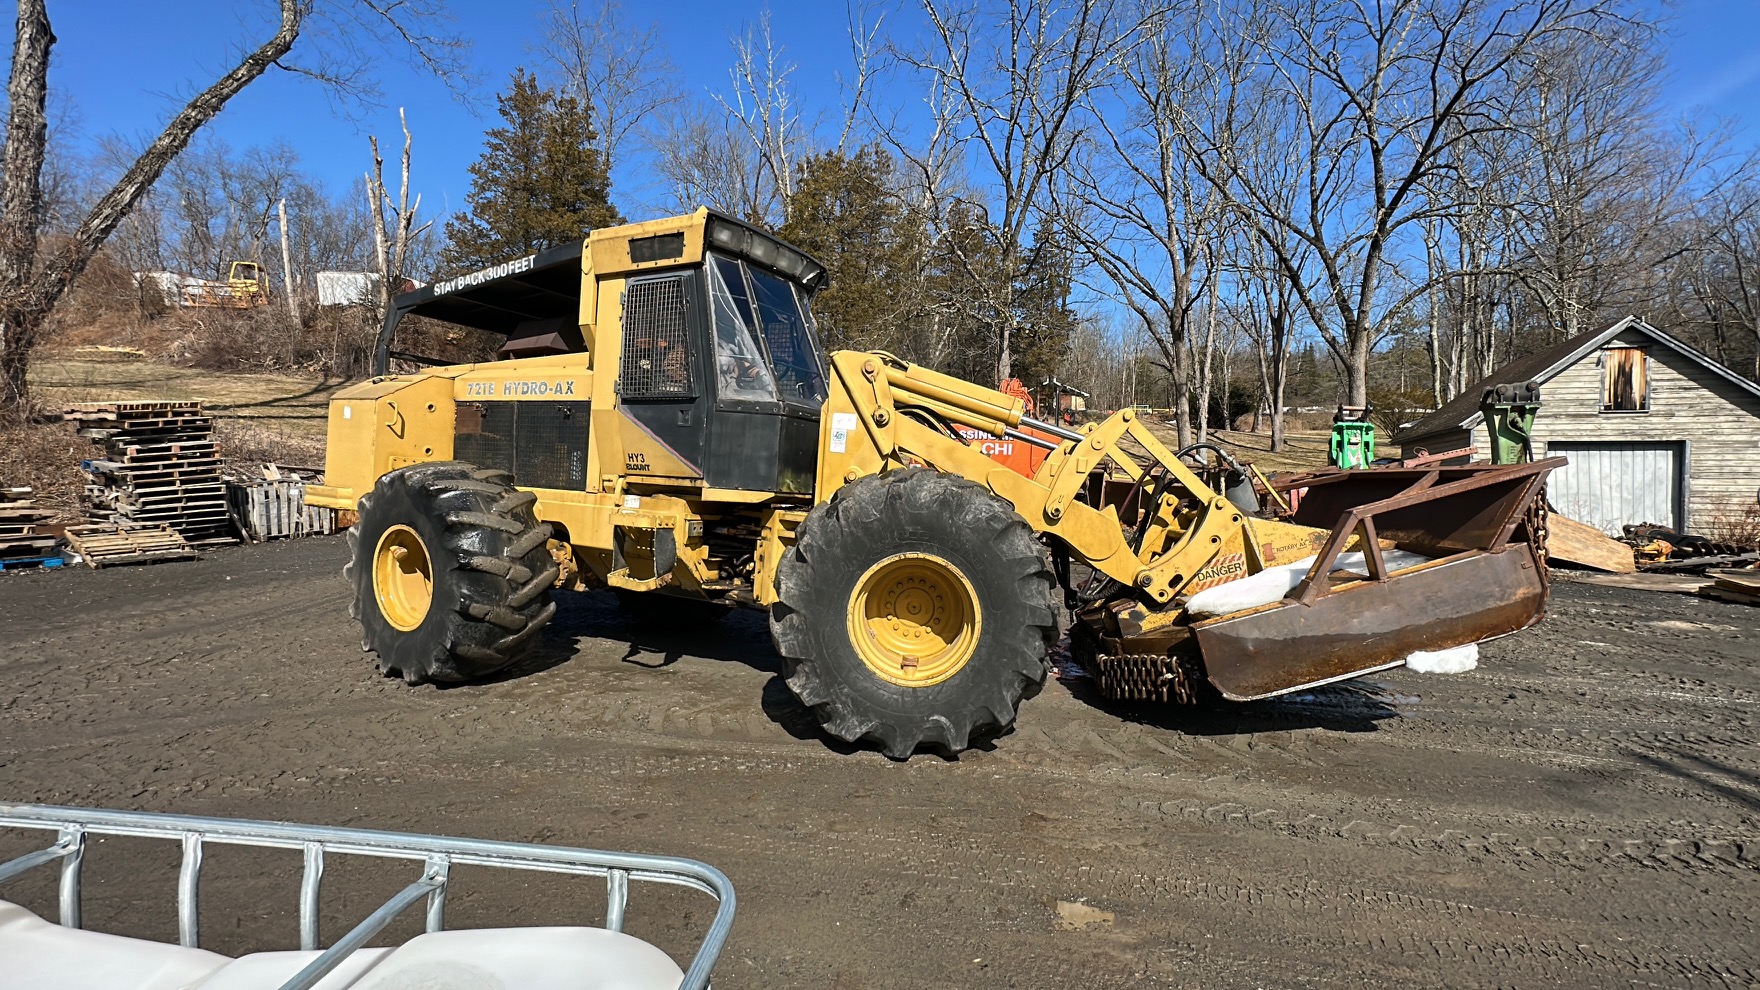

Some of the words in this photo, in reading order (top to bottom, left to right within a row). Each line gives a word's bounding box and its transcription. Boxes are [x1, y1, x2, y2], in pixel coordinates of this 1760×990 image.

[434, 280, 456, 296] STAY
[458, 269, 486, 290] BACK
[486, 262, 508, 280] 300
[508, 254, 536, 275] FEET
[466, 382, 495, 396] 721E
[503, 380, 575, 396] HYDRO-AX
[1276, 543, 1298, 552] ROTARY
[1197, 562, 1243, 582] DANGER
